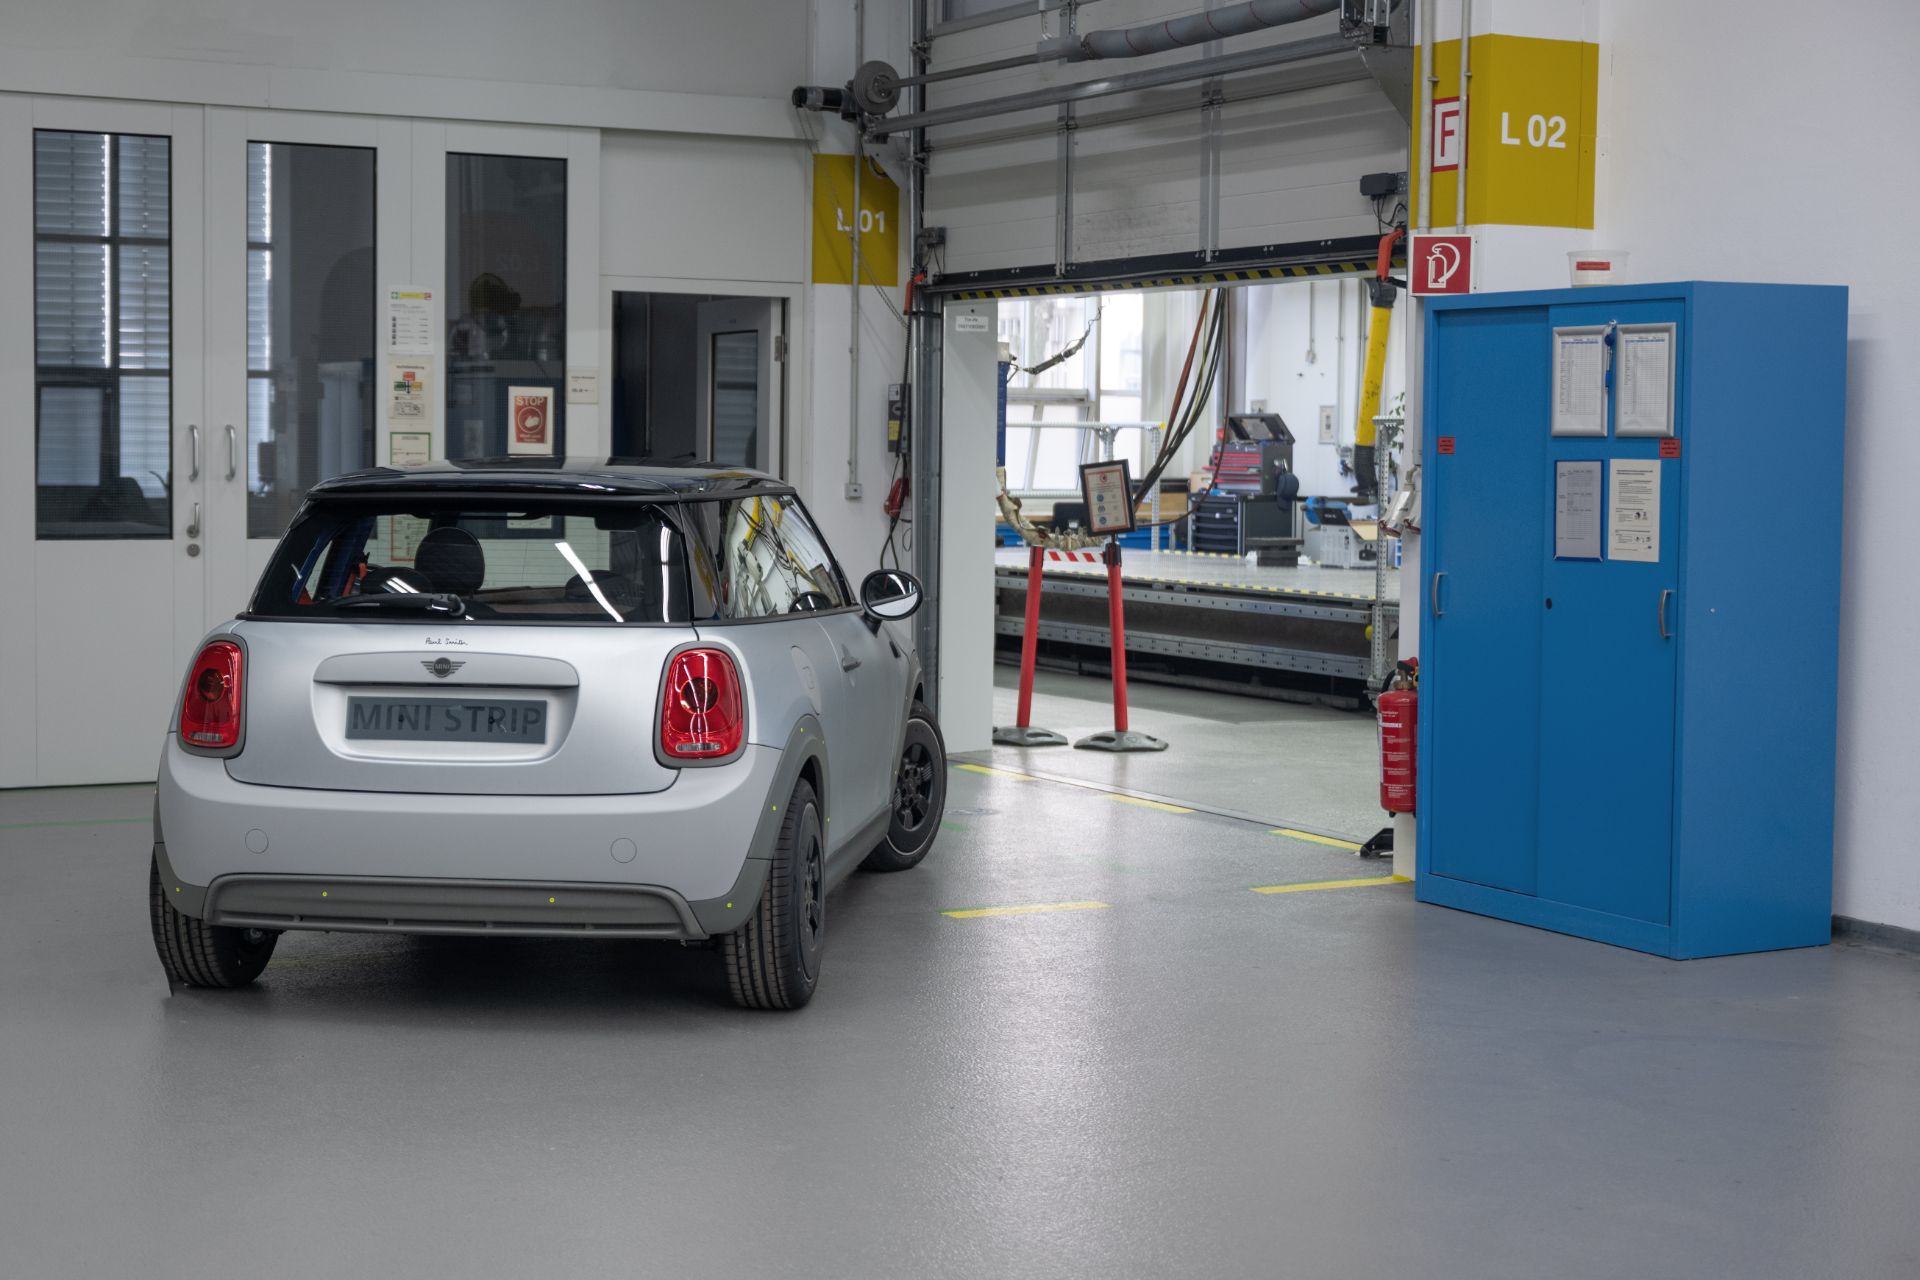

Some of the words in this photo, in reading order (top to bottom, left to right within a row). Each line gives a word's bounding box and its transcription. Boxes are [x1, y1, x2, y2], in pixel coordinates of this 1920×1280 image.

[1440, 110, 1460, 157] F
[1501, 112, 1521, 145] L
[1527, 114, 1567, 148] 02
[837, 207, 853, 231] L
[859, 209, 885, 233] 01
[515, 396, 545, 407] STOP
[434, 663, 450, 671] MINI
[352, 703, 432, 731] MINI
[444, 705, 542, 735] STRIP
